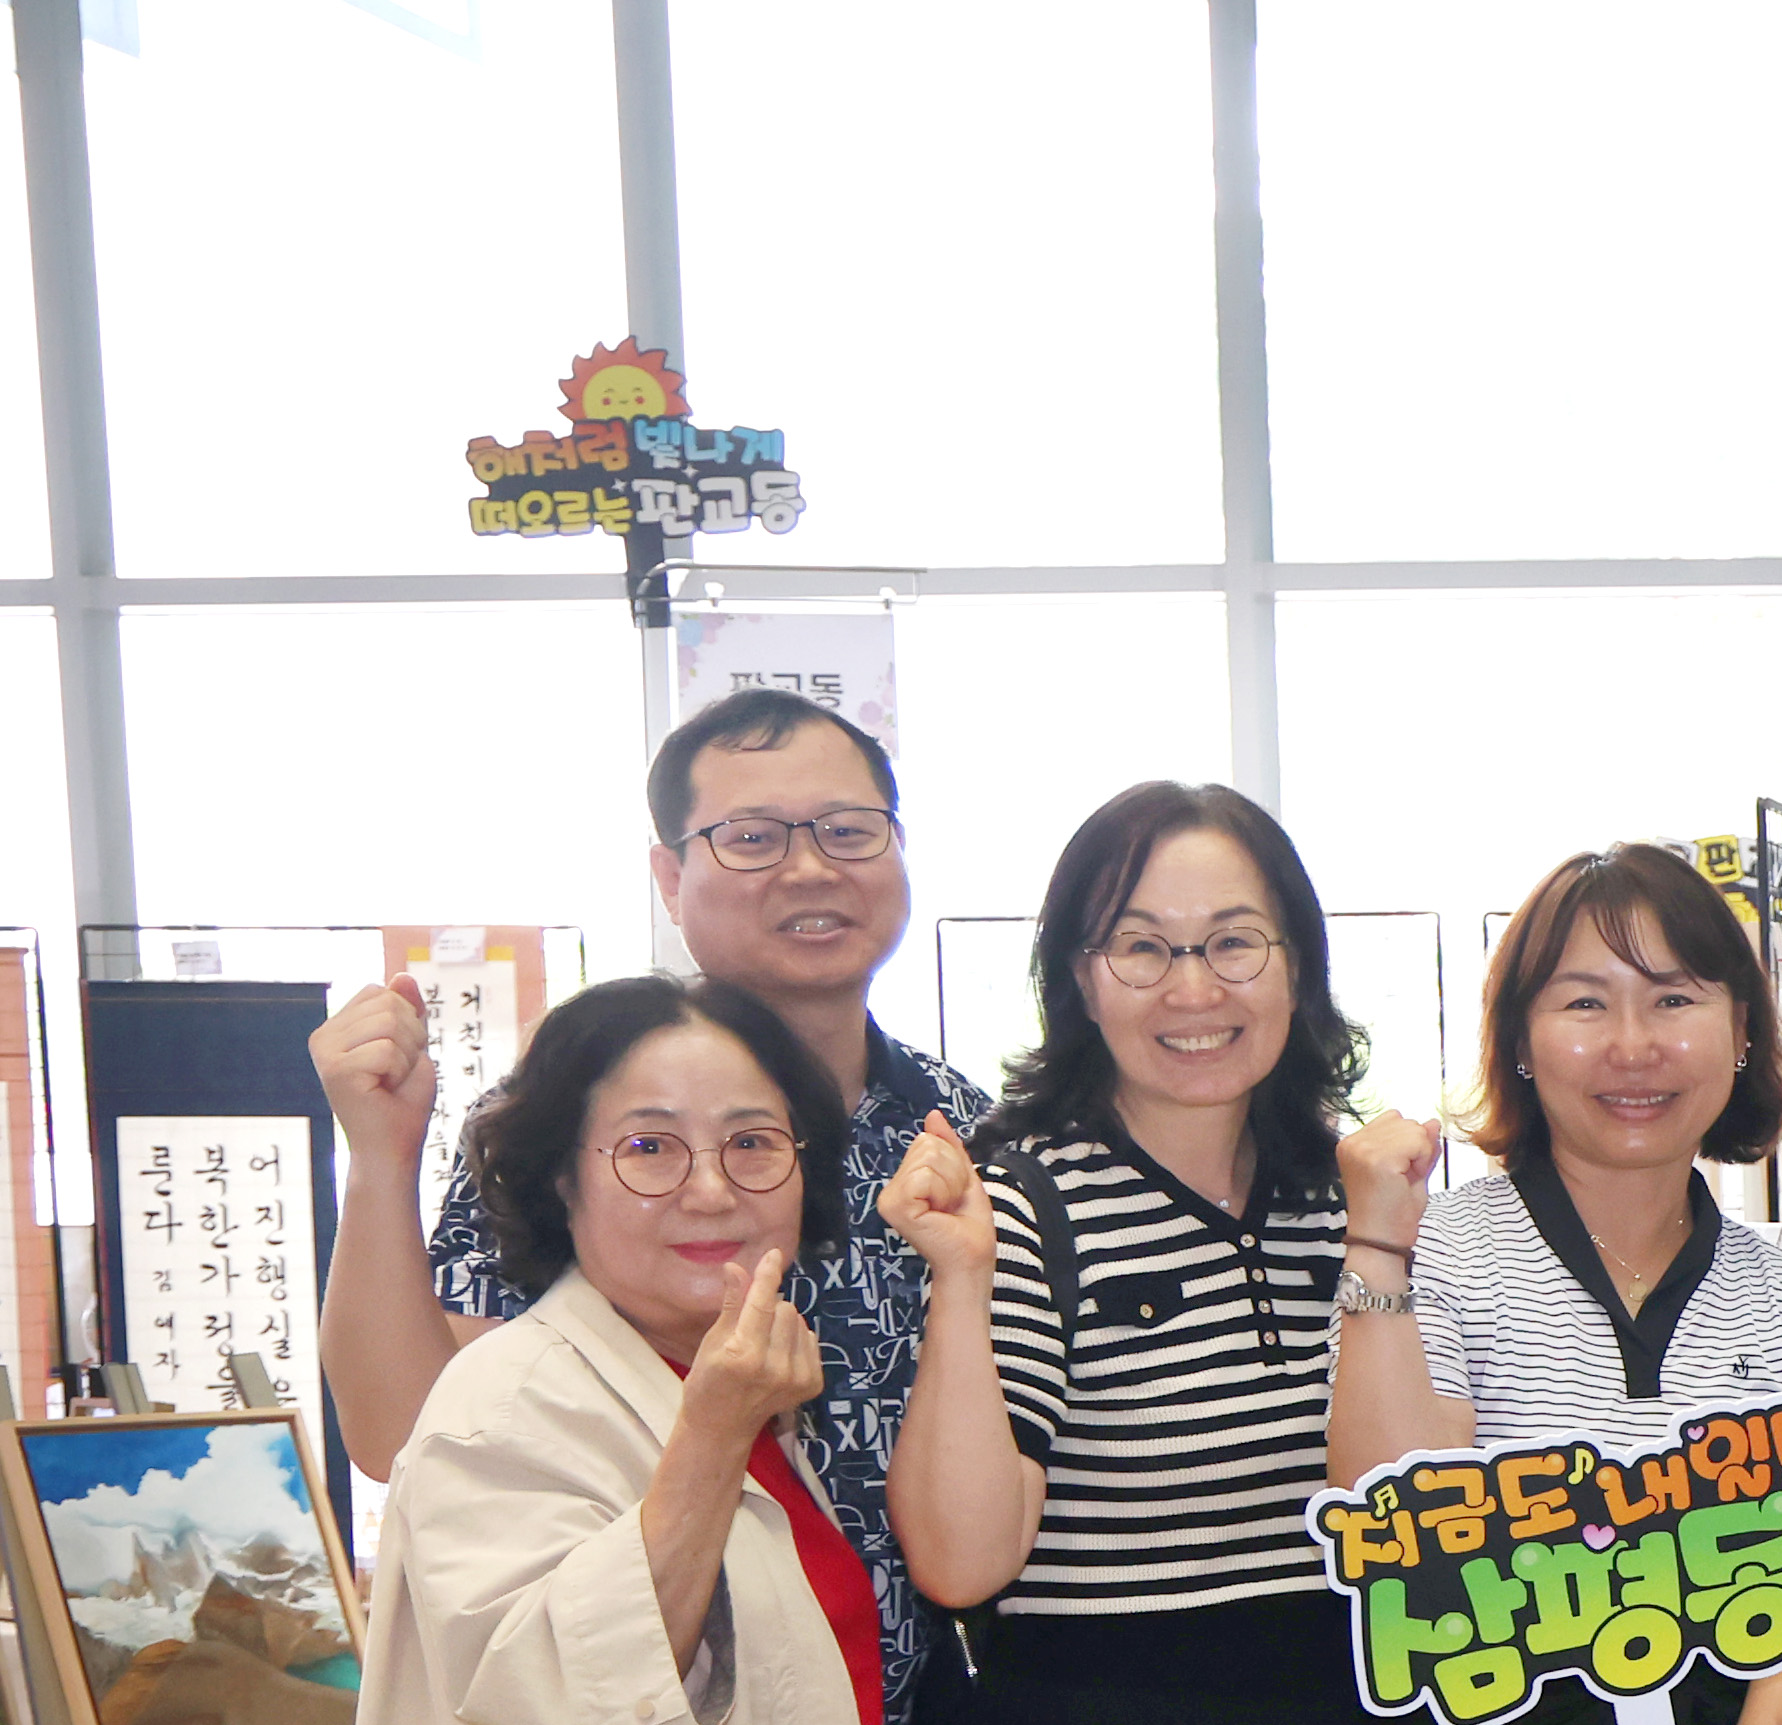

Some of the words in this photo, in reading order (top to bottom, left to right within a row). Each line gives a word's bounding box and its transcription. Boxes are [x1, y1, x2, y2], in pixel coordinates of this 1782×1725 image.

[467, 421, 629, 482] 해처럼
[633, 419, 785, 469] 빛나게
[469, 488, 632, 536] 떠오르는
[631, 471, 804, 535] 판교동
[1324, 1453, 1577, 1579] 지금도
